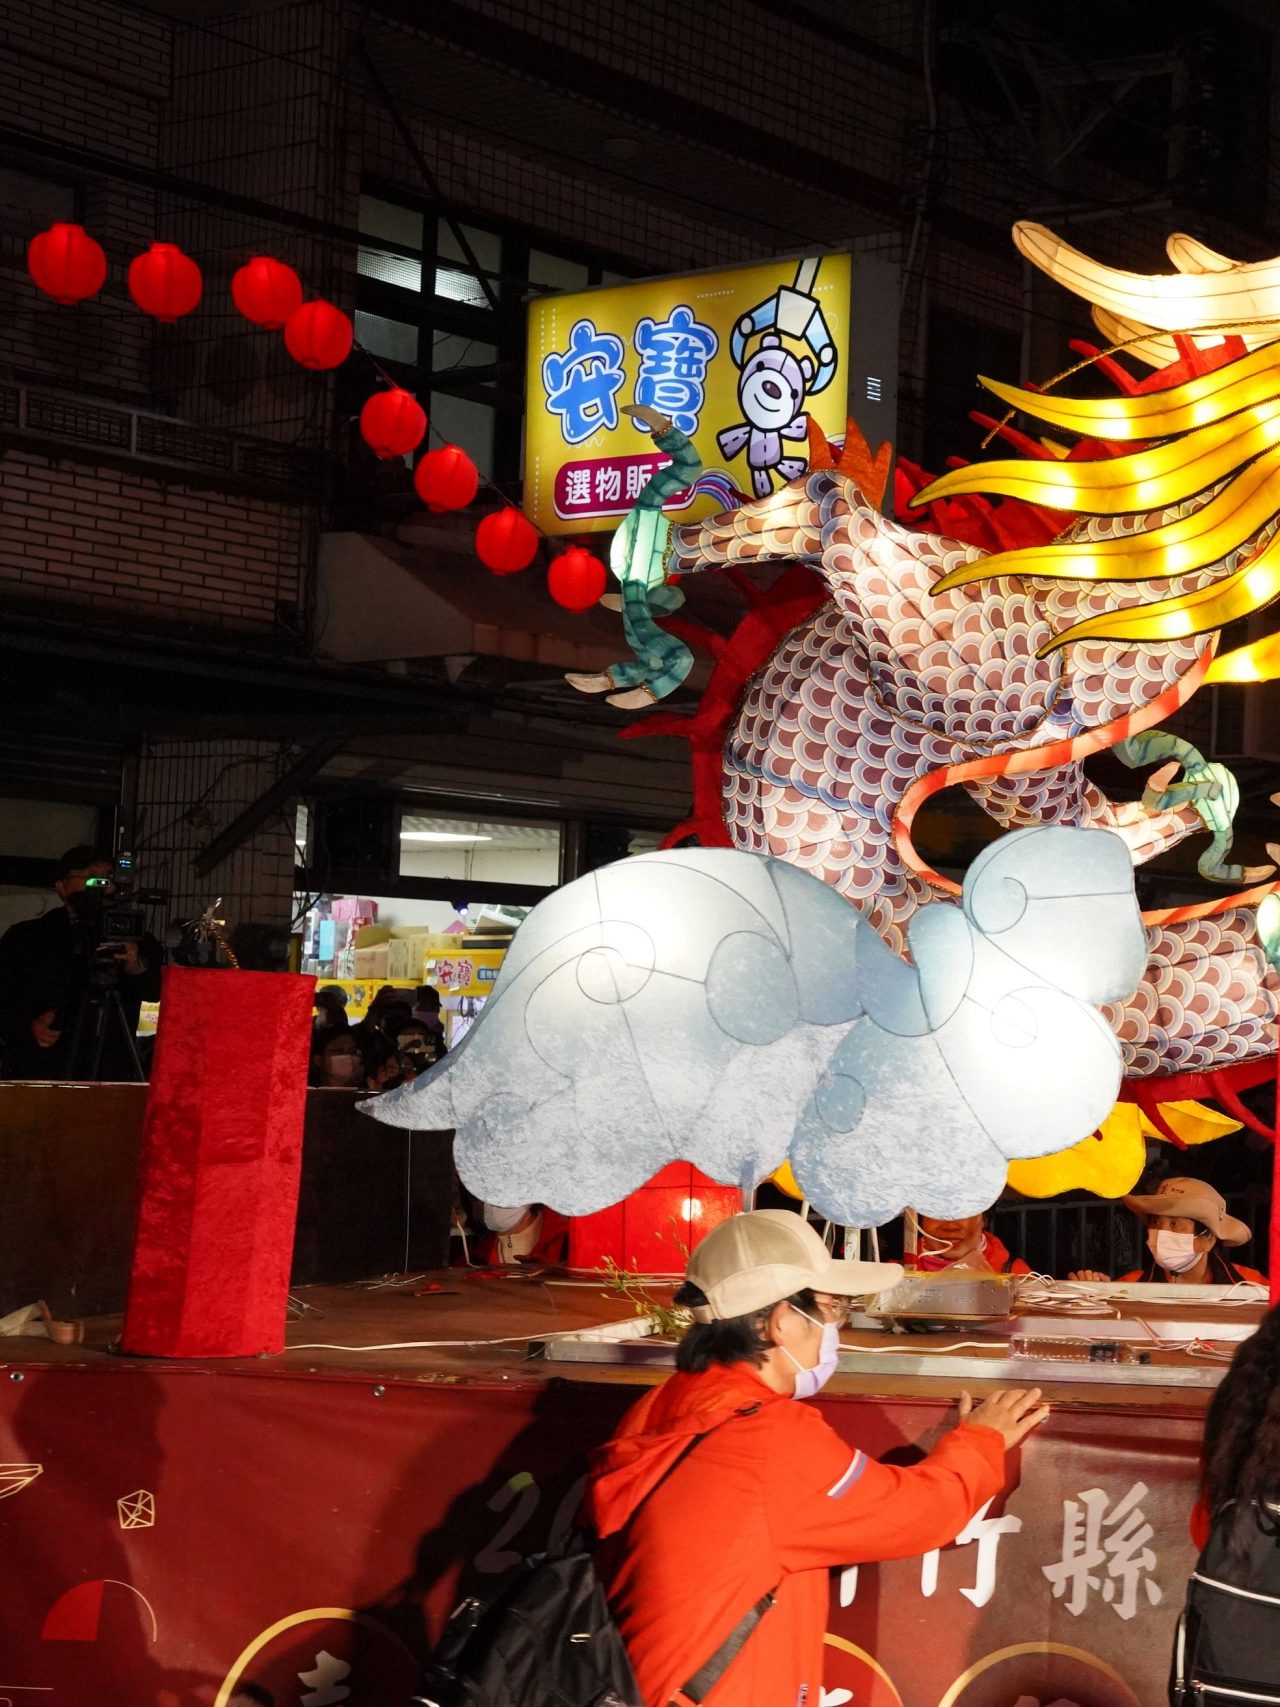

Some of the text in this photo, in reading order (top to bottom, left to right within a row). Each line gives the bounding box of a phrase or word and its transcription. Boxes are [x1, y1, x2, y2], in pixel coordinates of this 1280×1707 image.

[543, 305, 718, 446] 安寶
[565, 462, 694, 506] 選物販
[838, 1481, 1164, 1621] 竹縣
